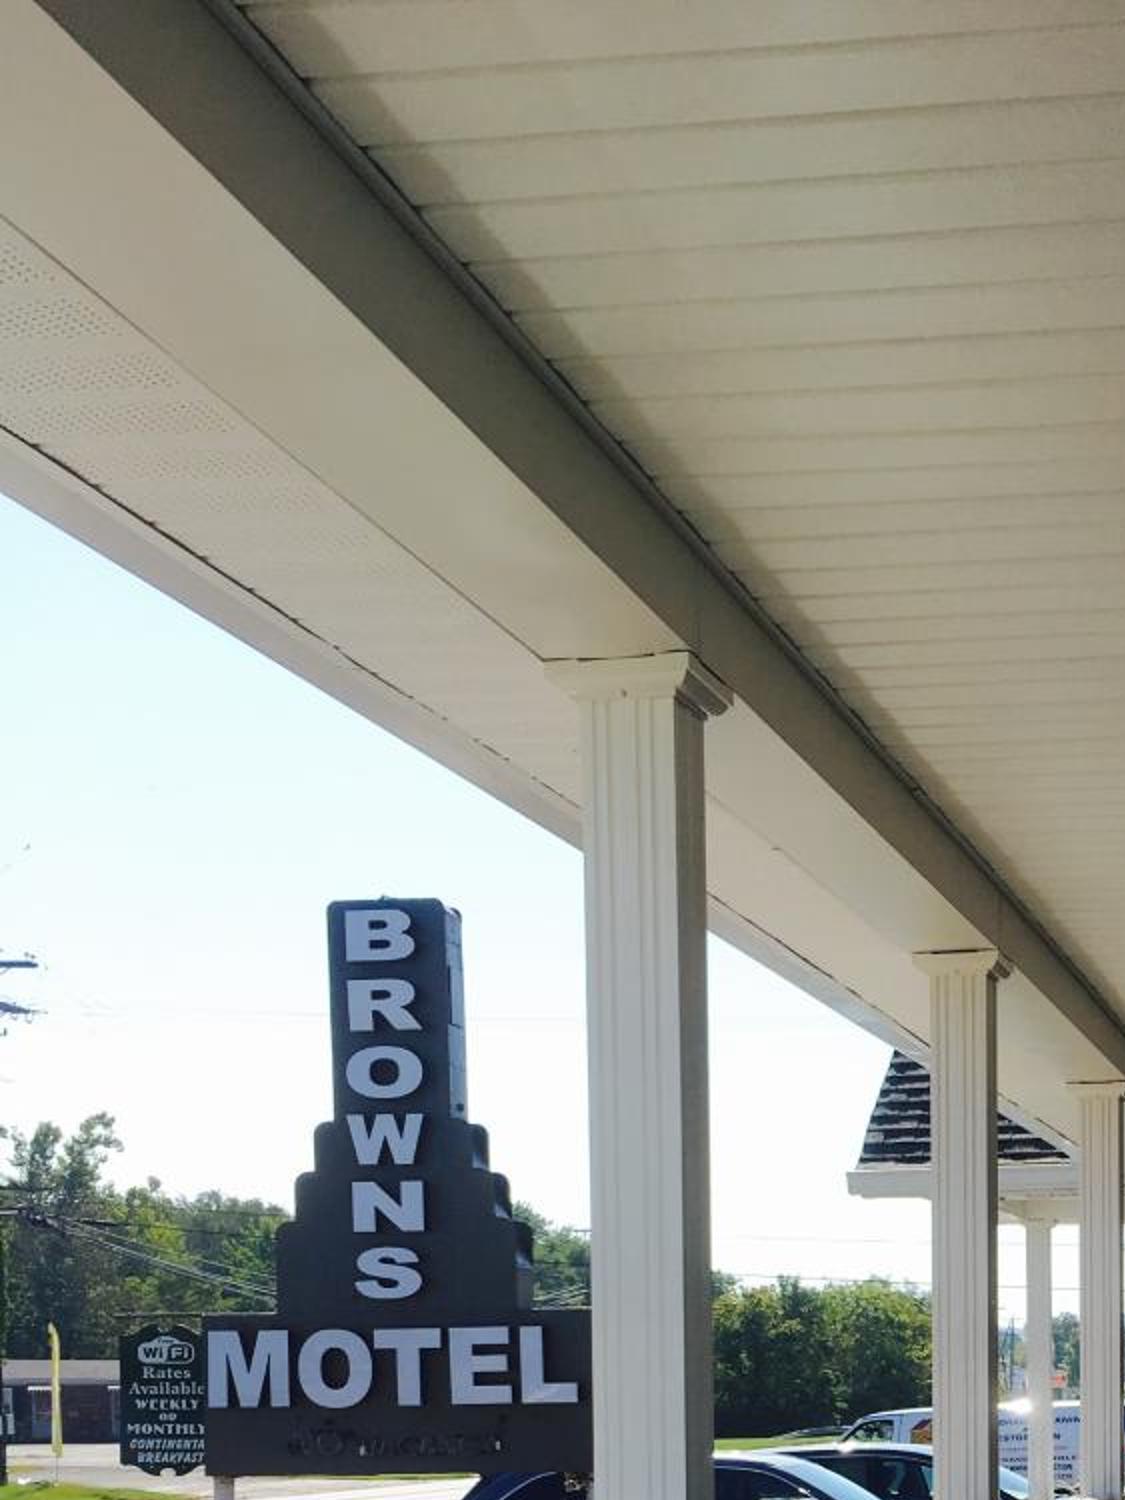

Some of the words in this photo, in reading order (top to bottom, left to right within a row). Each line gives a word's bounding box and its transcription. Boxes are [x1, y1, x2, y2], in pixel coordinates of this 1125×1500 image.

[343, 909, 425, 1299] BROWNS
[142, 1366, 191, 1379] Rates
[206, 1325, 579, 1409] MOTEL
[129, 1381, 205, 1395] Available
[136, 1399, 199, 1411] WEEKLY
[127, 1423, 205, 1435] MONTHLY
[129, 1438, 205, 1450] CONTINENTA
[137, 1452, 205, 1464] BREAKFAST
